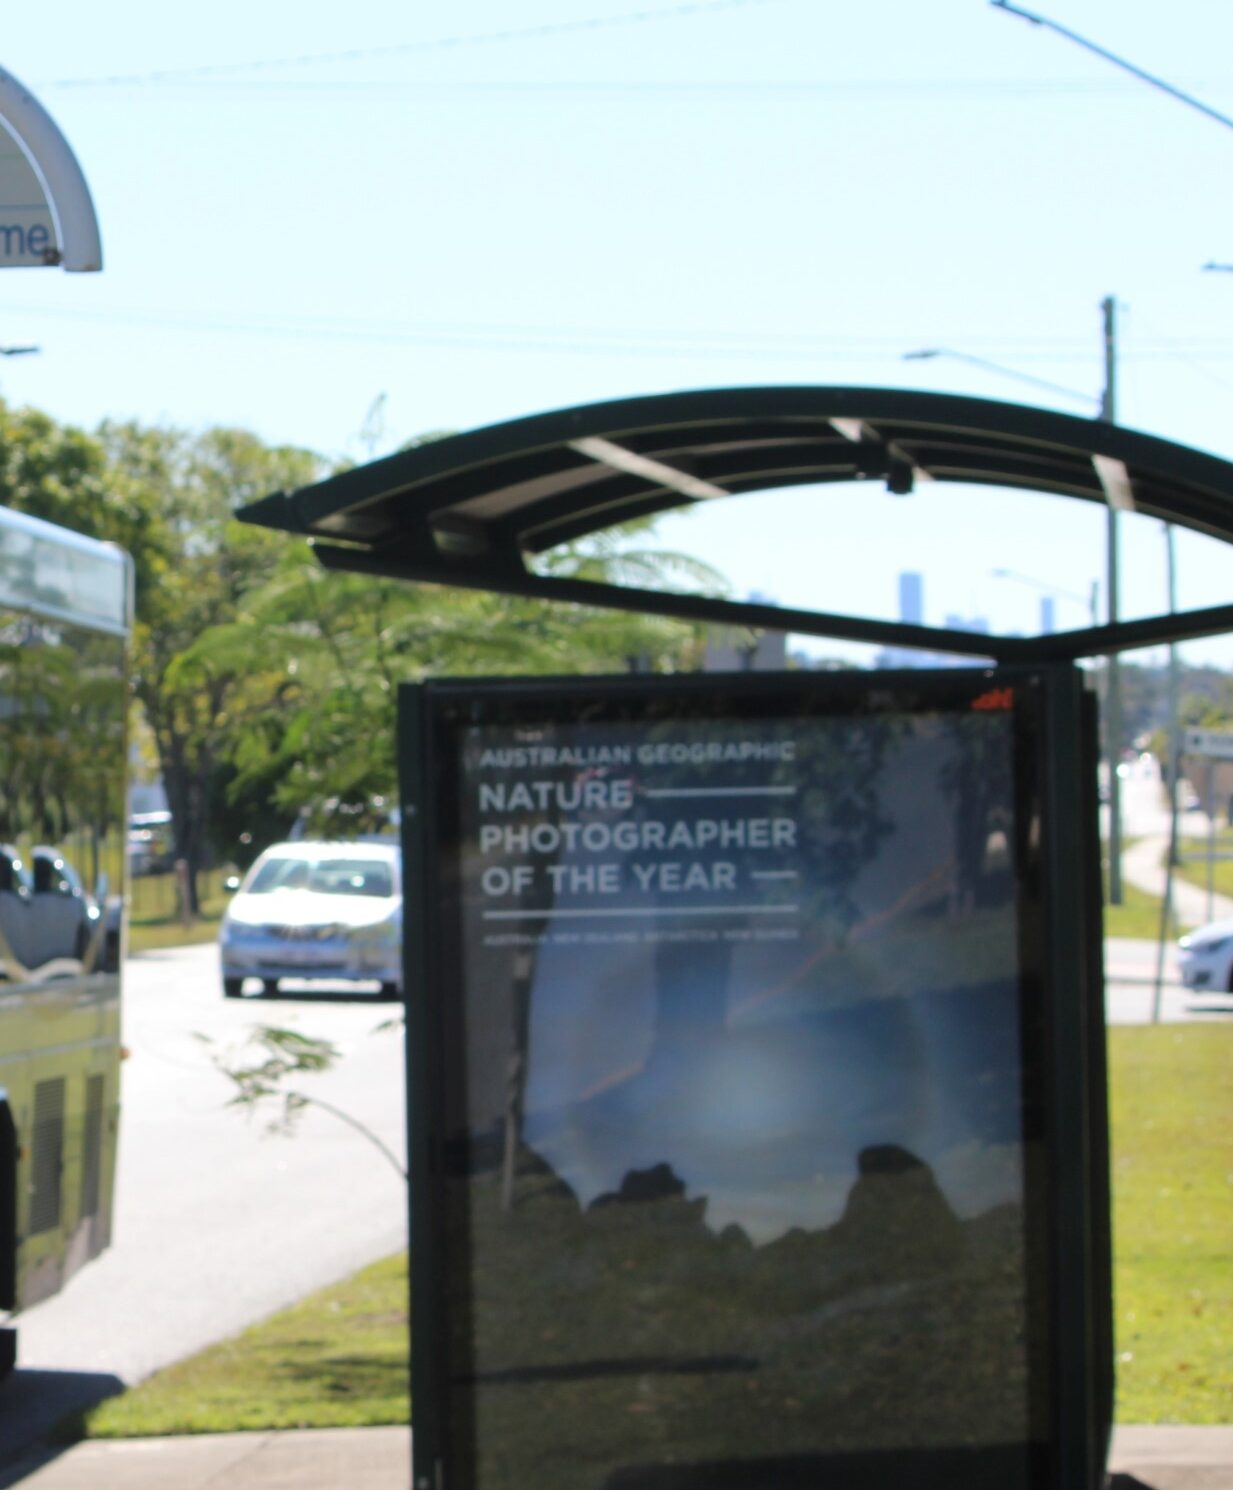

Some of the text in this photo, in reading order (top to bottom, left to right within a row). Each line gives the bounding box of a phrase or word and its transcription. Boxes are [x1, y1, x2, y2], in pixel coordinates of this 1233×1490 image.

[479, 740, 797, 769] AUSTRALIAN GEOGRAPHIC
[479, 779, 634, 812] NATURE
[479, 817, 798, 854] PHOTOGRAPHER
[481, 861, 738, 896] OF THE YEAR
